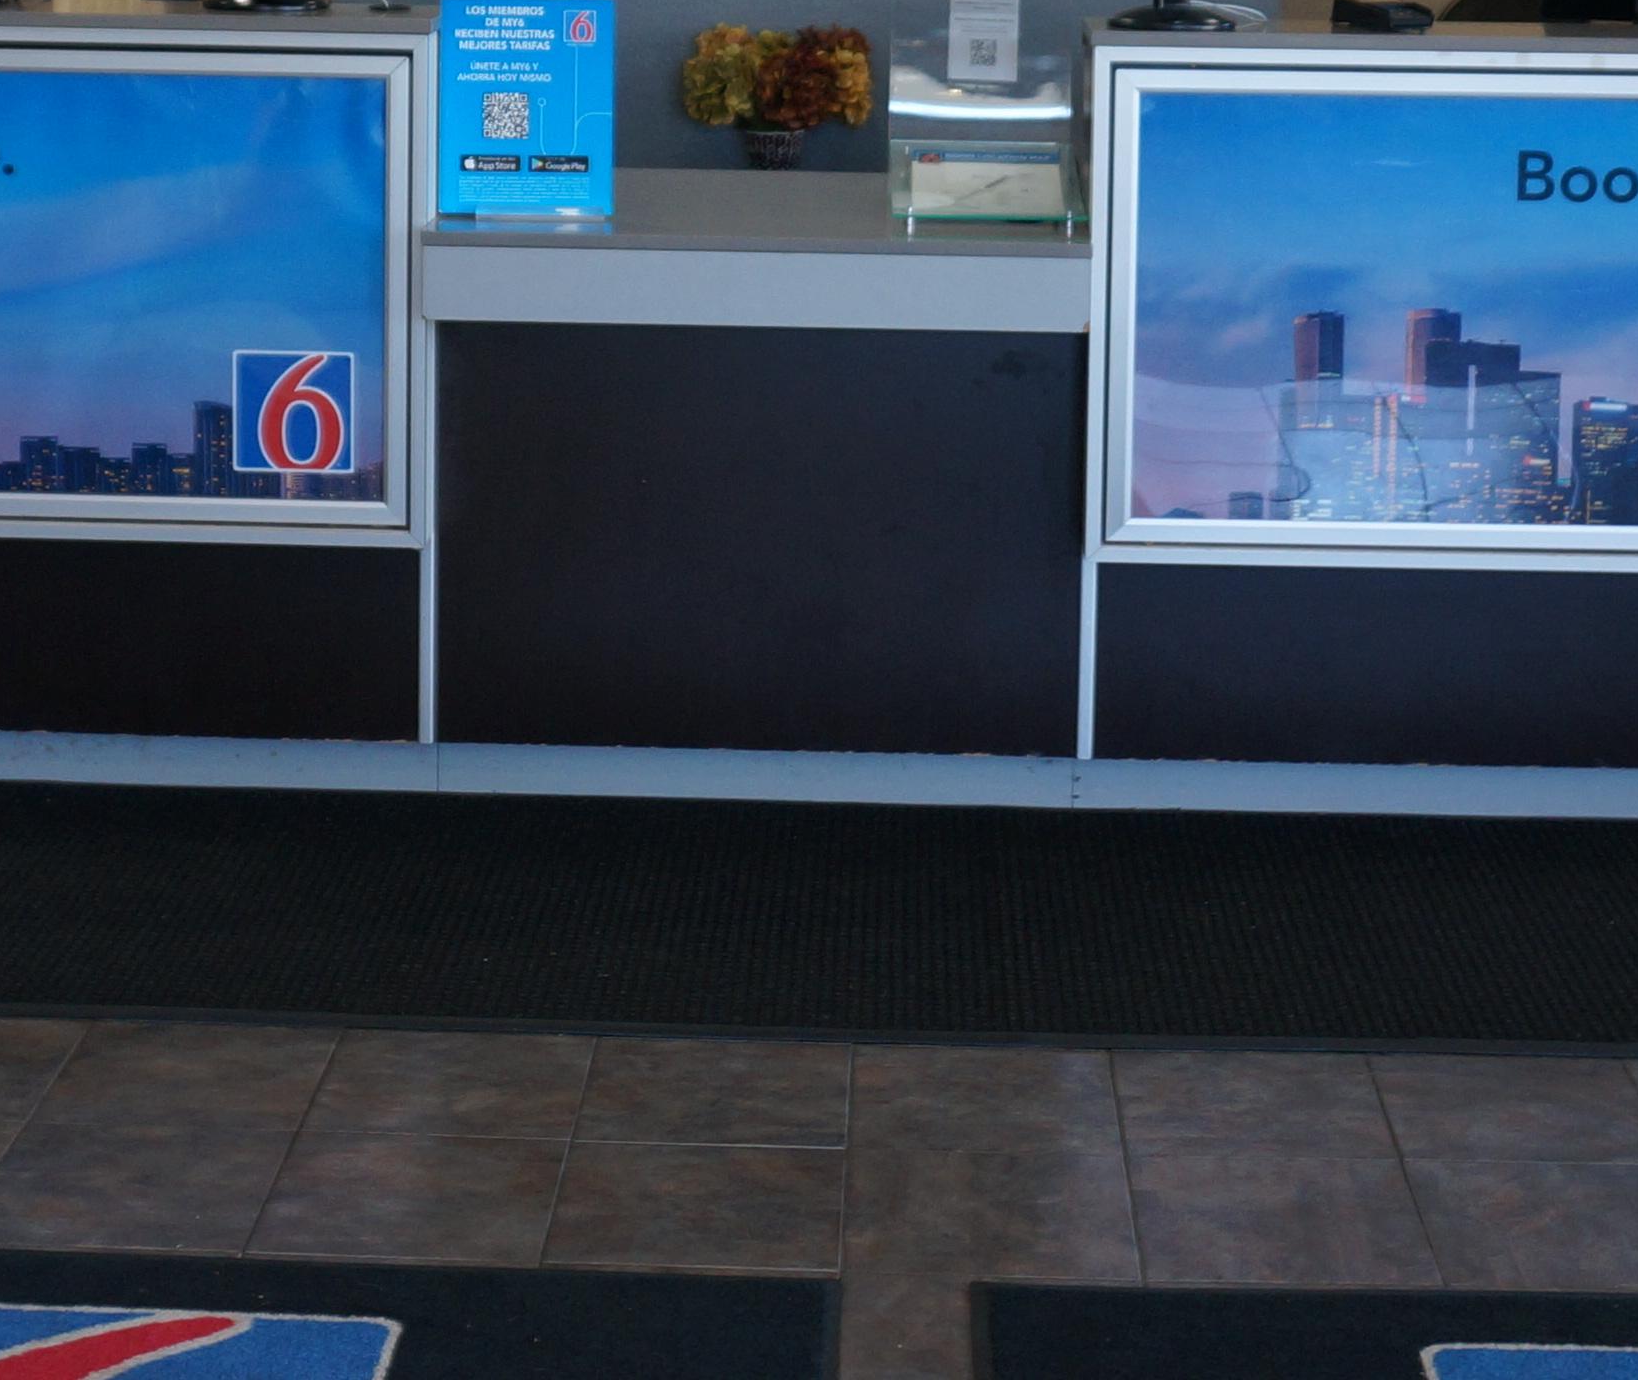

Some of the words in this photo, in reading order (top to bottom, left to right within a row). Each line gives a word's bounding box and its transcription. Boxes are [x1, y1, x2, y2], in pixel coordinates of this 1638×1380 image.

[466, 6, 485, 15] LOS
[488, 6, 545, 16] MIEMBROS
[570, 10, 594, 42] 6
[455, 29, 498, 38] RECIBEN
[501, 29, 554, 39] NUESTRAS
[459, 40, 507, 50] MEJORES
[510, 41, 550, 50] TARIFAS
[258, 352, 344, 472] 6
